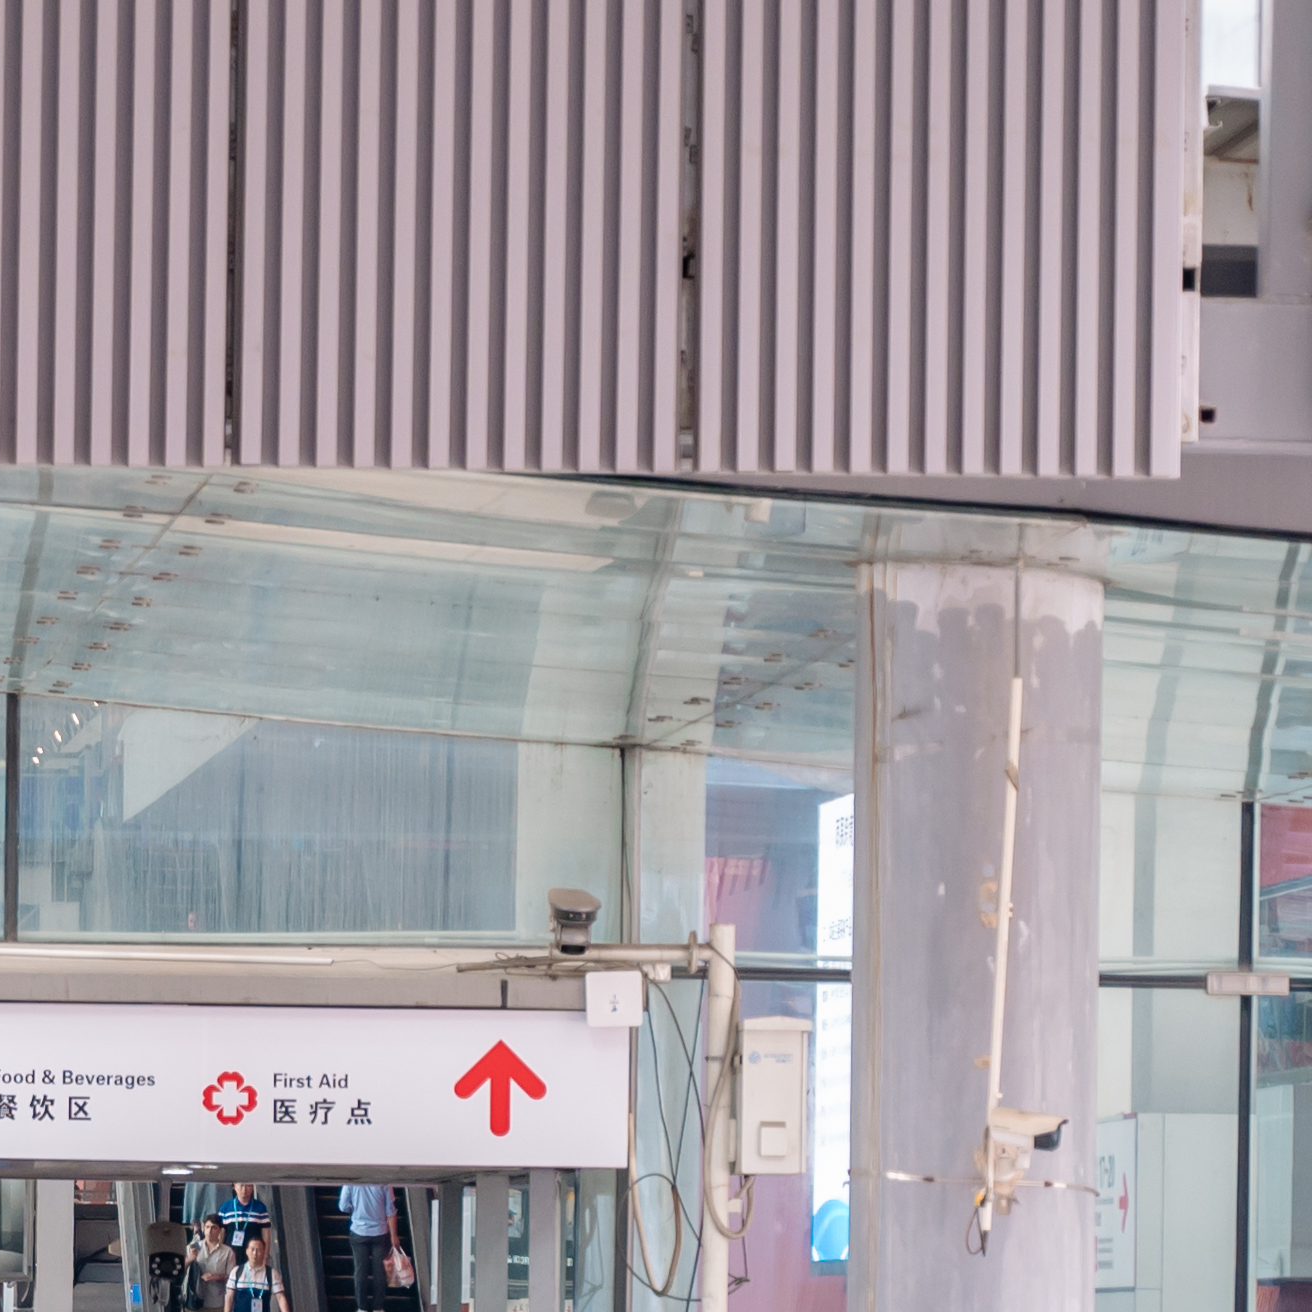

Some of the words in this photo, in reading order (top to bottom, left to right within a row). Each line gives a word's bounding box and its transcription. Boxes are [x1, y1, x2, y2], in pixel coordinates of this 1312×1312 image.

[42, 1070, 55, 1084] &
[63, 1070, 155, 1089] Beverages
[274, 1073, 311, 1088] First
[319, 1074, 348, 1088] Aid
[274, 1099, 372, 1125] 医疗点
